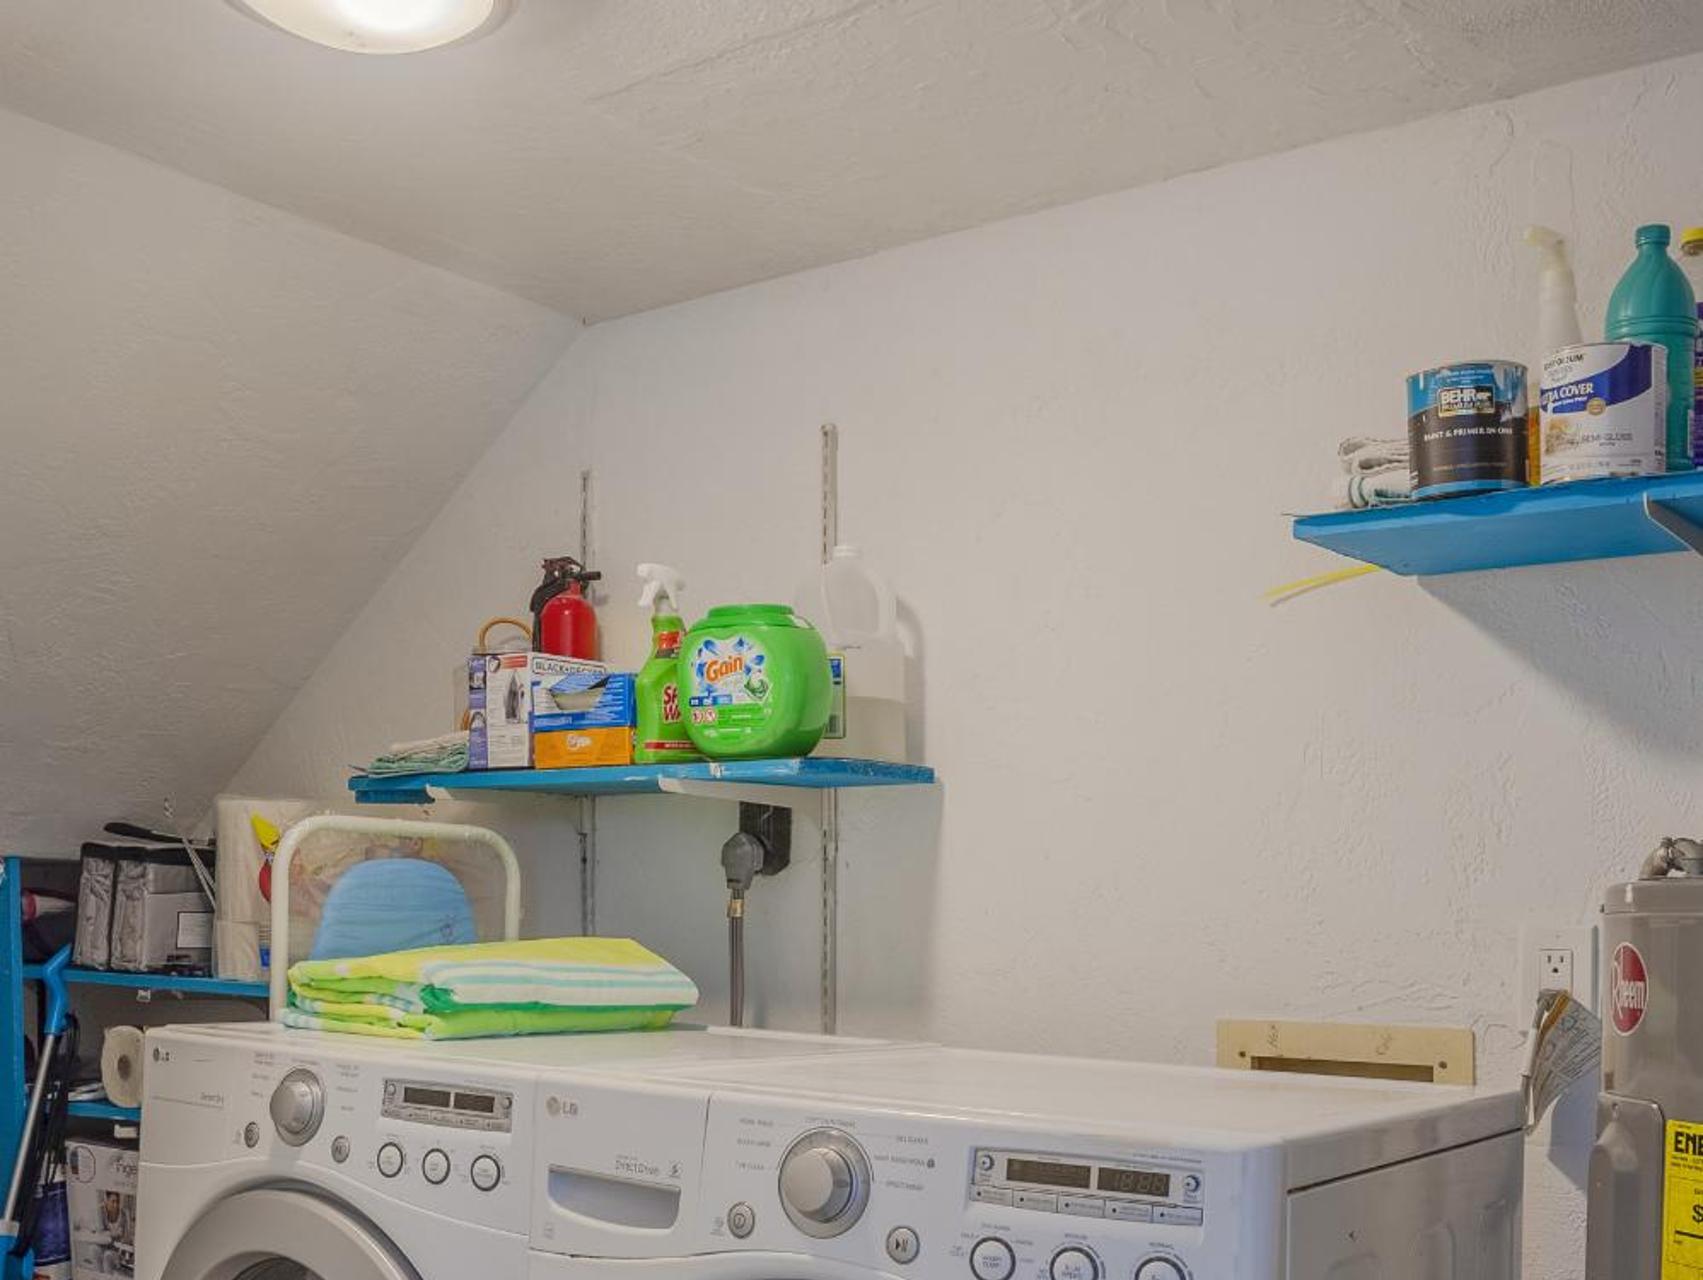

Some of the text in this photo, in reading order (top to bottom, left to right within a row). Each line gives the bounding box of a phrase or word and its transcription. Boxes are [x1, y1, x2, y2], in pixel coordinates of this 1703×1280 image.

[1441, 387, 1476, 404] BEHR
[1559, 382, 1595, 398] COVER
[705, 655, 744, 682] Gain
